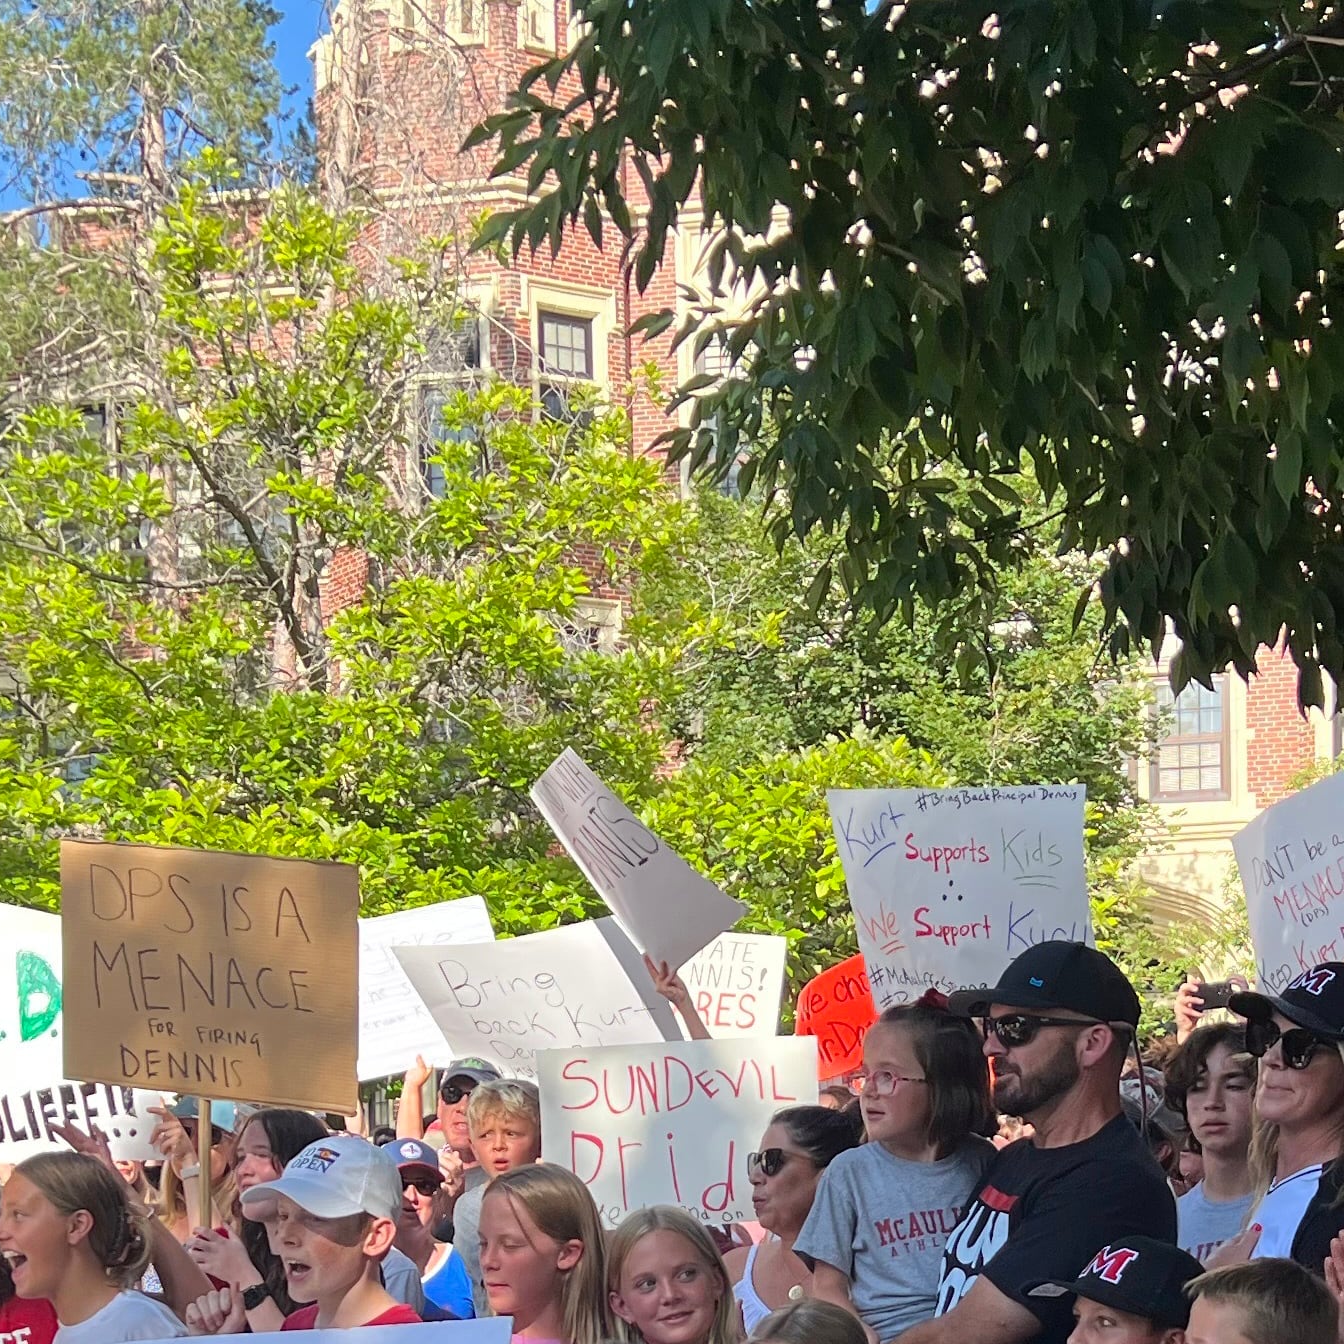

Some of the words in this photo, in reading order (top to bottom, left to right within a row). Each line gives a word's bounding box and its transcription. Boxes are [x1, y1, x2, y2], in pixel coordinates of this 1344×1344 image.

[837, 802, 906, 862] Kurt
[905, 832, 990, 874] Supports
[1000, 827, 1064, 873] Kids
[1304, 839, 1328, 862] be
[89, 863, 195, 935] DPS
[221, 883, 253, 938] IS
[275, 886, 312, 944] A
[858, 901, 901, 944] We
[914, 906, 992, 947] Support
[699, 939, 760, 963] ATE
[93, 939, 315, 1014] MENACE
[438, 959, 566, 1008] Bring
[690, 963, 768, 992] NNIS!
[1289, 968, 1337, 996] M
[473, 1009, 558, 1040] back
[563, 1003, 657, 1038] Kurt
[697, 991, 757, 1030] RES
[148, 1016, 178, 1039] FOR
[195, 1025, 263, 1059] FIRING
[120, 1042, 244, 1089] DENNIS
[290, 1157, 333, 1175] OPEN
[570, 1130, 736, 1212] Prid
[1078, 1244, 1140, 1286] M
